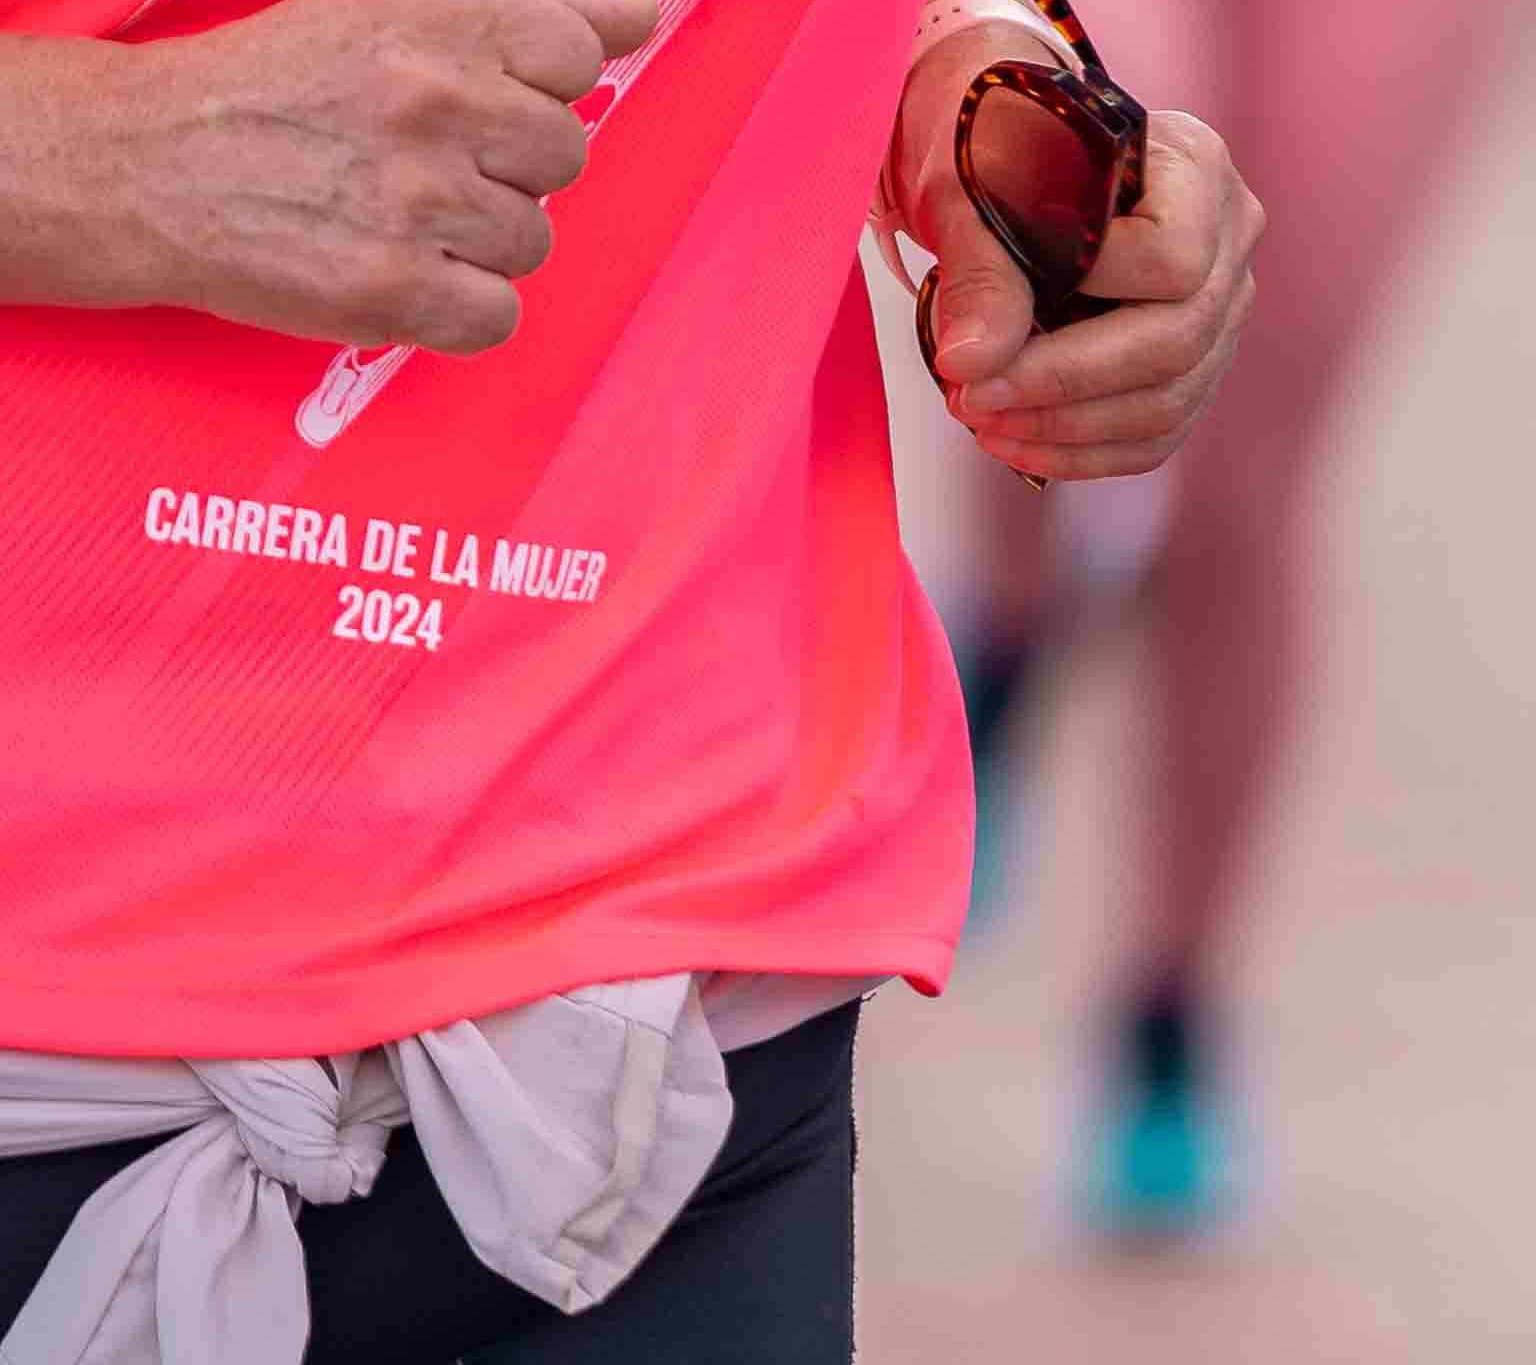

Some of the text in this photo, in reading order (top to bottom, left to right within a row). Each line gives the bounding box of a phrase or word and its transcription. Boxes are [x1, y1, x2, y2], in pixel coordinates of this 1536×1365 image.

[144, 486, 608, 603] CARRERA DE LA MUJER
[332, 585, 445, 651] 2024
